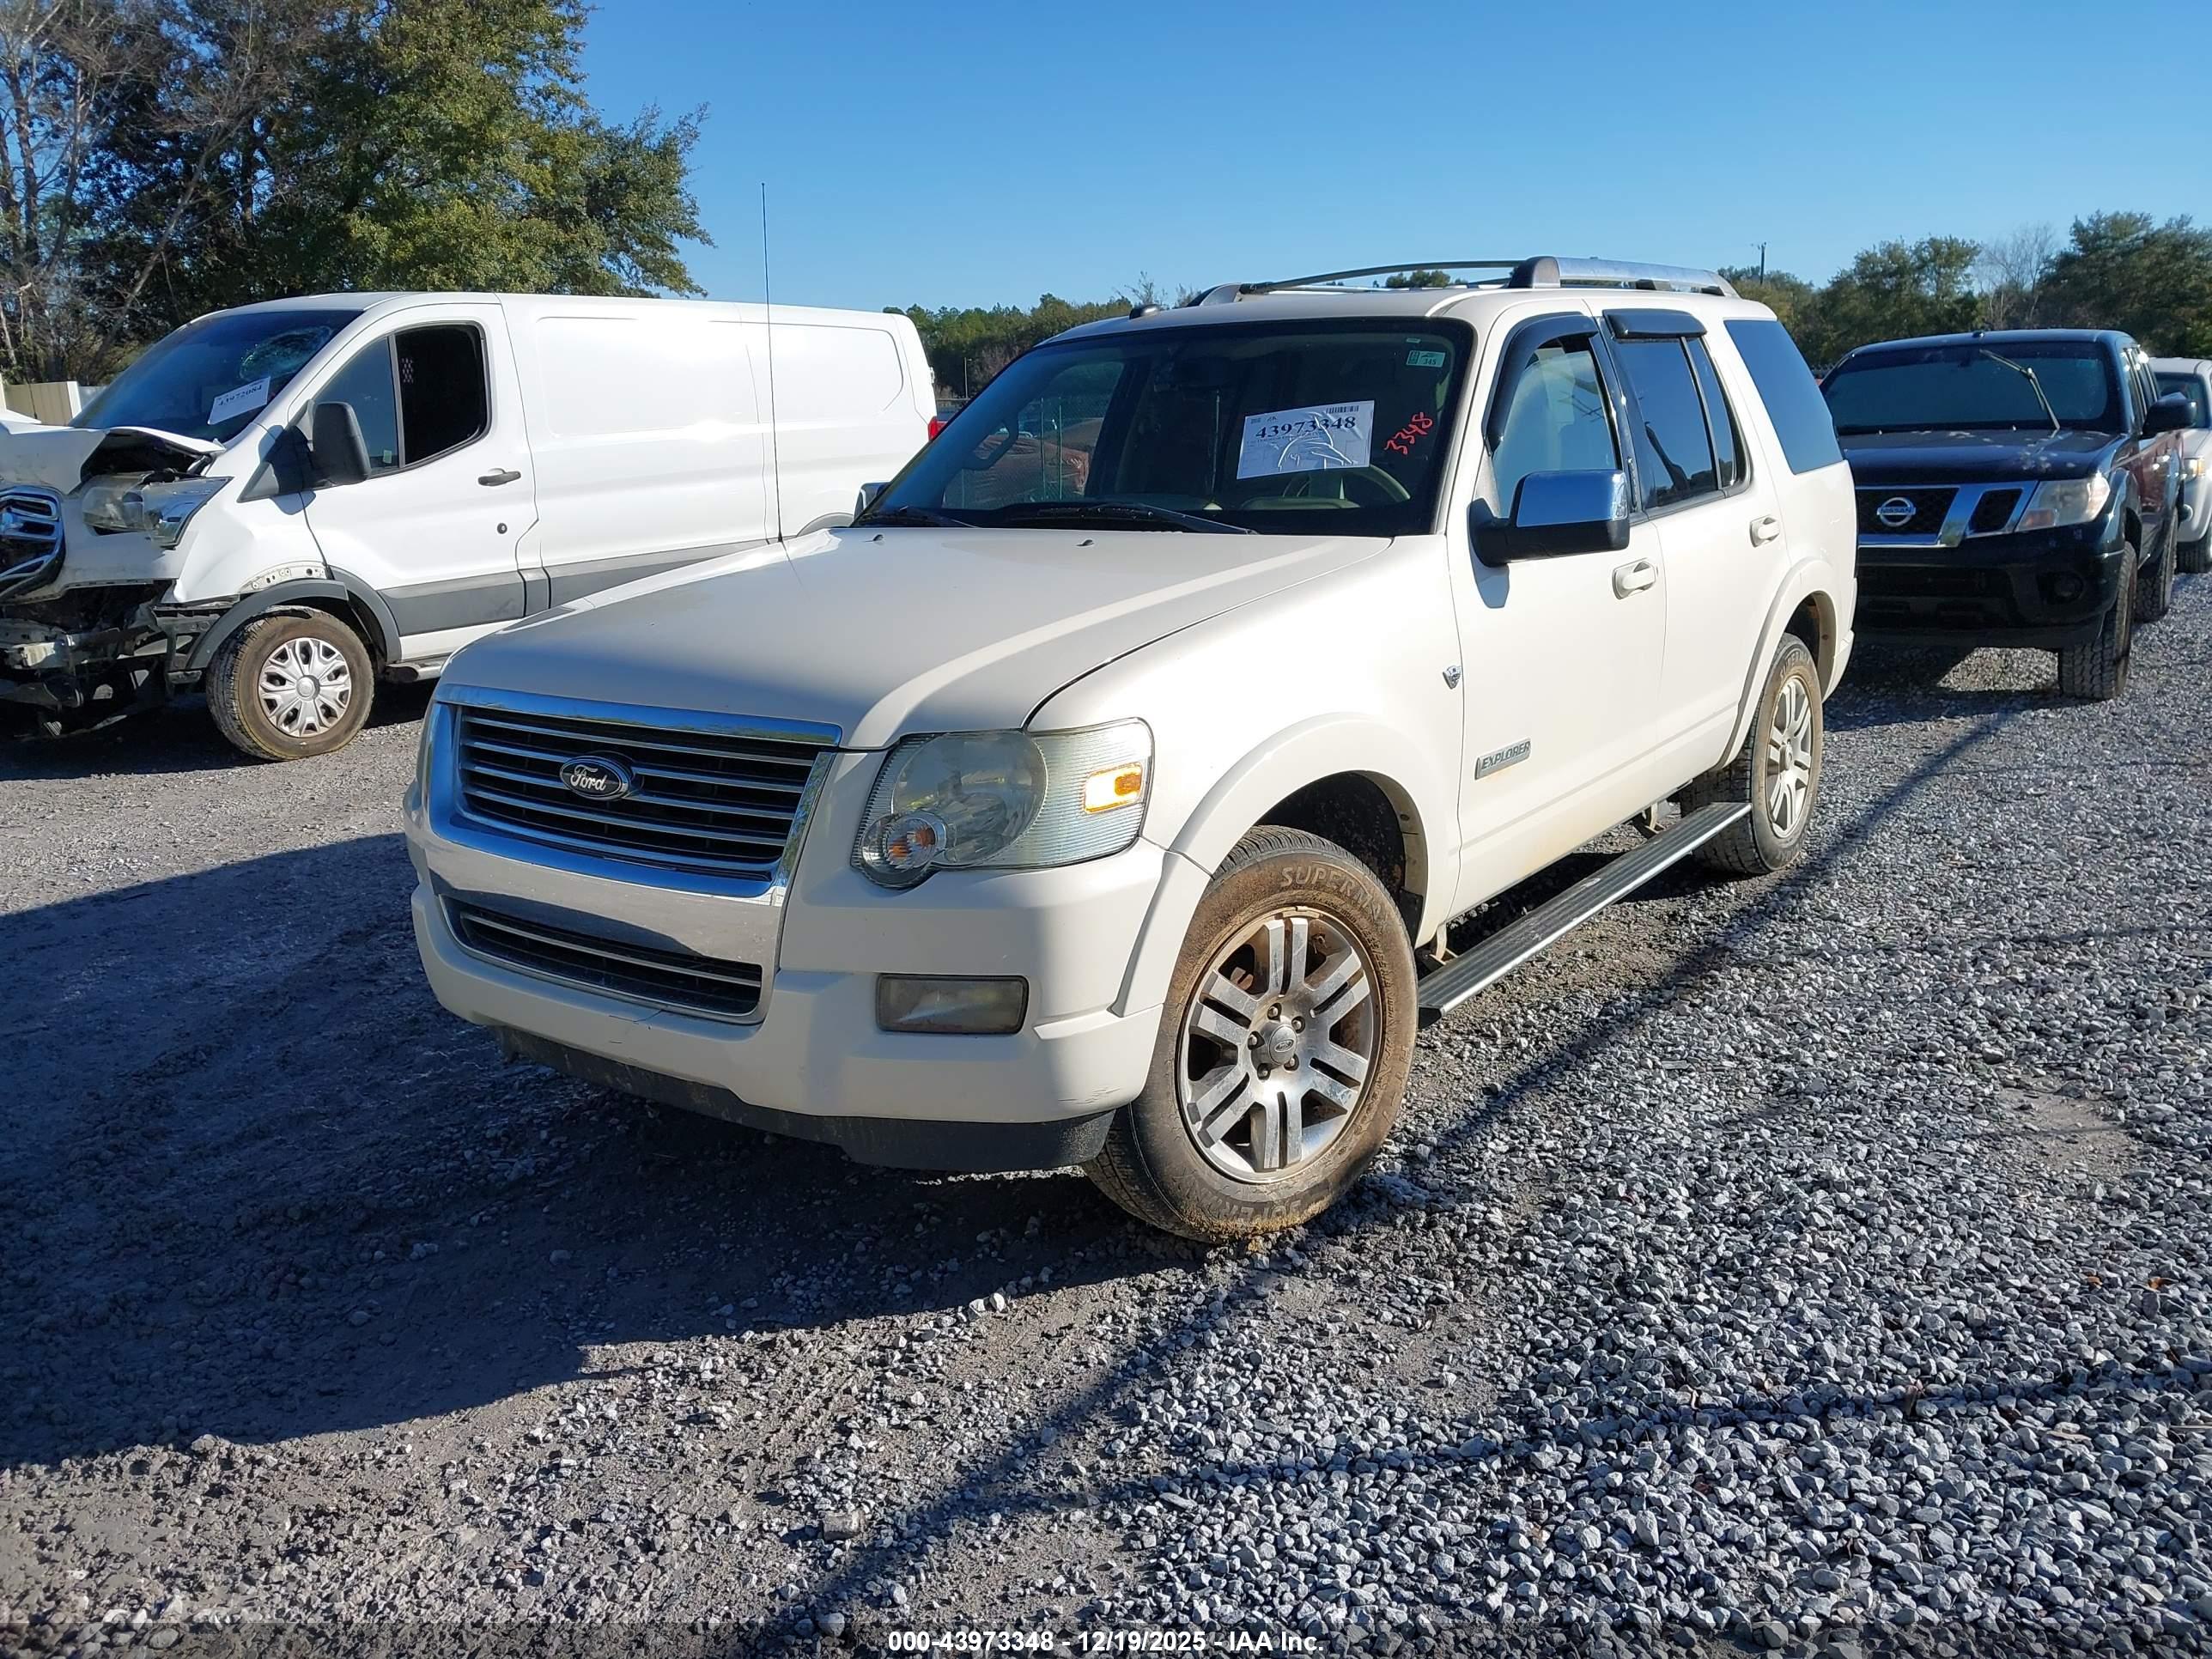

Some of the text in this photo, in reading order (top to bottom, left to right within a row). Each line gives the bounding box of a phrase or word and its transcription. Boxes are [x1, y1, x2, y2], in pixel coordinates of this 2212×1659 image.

[1255, 416, 1357, 439] 43973348
[1383, 412, 1433, 455] 3348
[1480, 740, 1531, 770] EXPLORER
[570, 764, 609, 791] Ford
